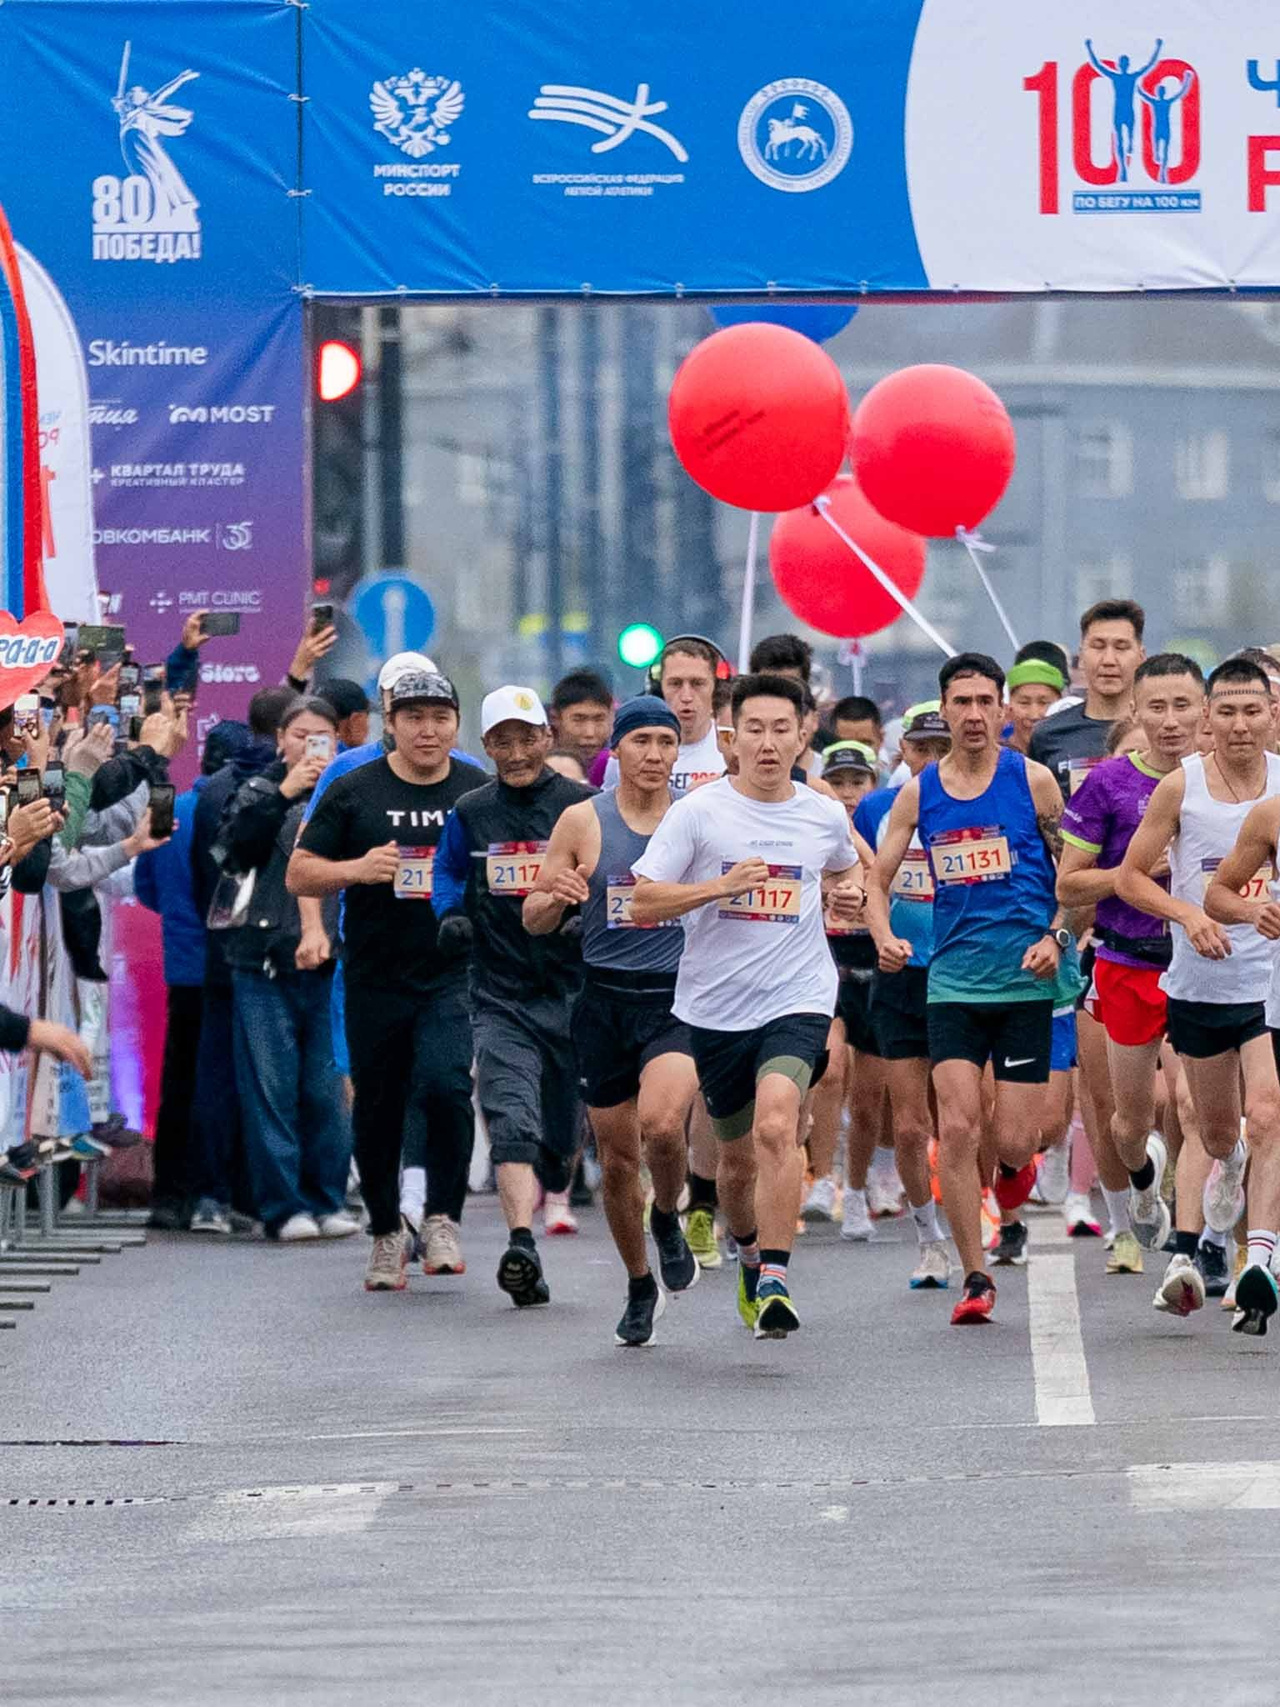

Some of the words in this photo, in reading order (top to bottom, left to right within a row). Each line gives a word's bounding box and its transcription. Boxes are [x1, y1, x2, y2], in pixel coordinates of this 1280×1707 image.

[1023, 57, 1202, 215] 100
[373, 163, 461, 178] МИНСПОРТ
[383, 182, 452, 197] РОССИИ
[92, 174, 154, 224] 80
[1075, 196, 1096, 208] ПО
[1097, 196, 1131, 208] БЕГУ
[1132, 195, 1154, 207] НА
[1154, 196, 1179, 208] 100
[92, 234, 201, 264] ПОБЕДА!
[87, 340, 209, 366] Skintime
[210, 404, 276, 424] MOST
[110, 464, 184, 477] КВАРТАЛ
[188, 463, 245, 477] ТРУДА
[91, 529, 212, 544] ОВКОМБАНК
[386, 809, 453, 827] TIM
[942, 849, 1001, 873] 21131
[402, 869, 433, 886] 21
[494, 864, 541, 883] 2117
[902, 871, 934, 888] 21
